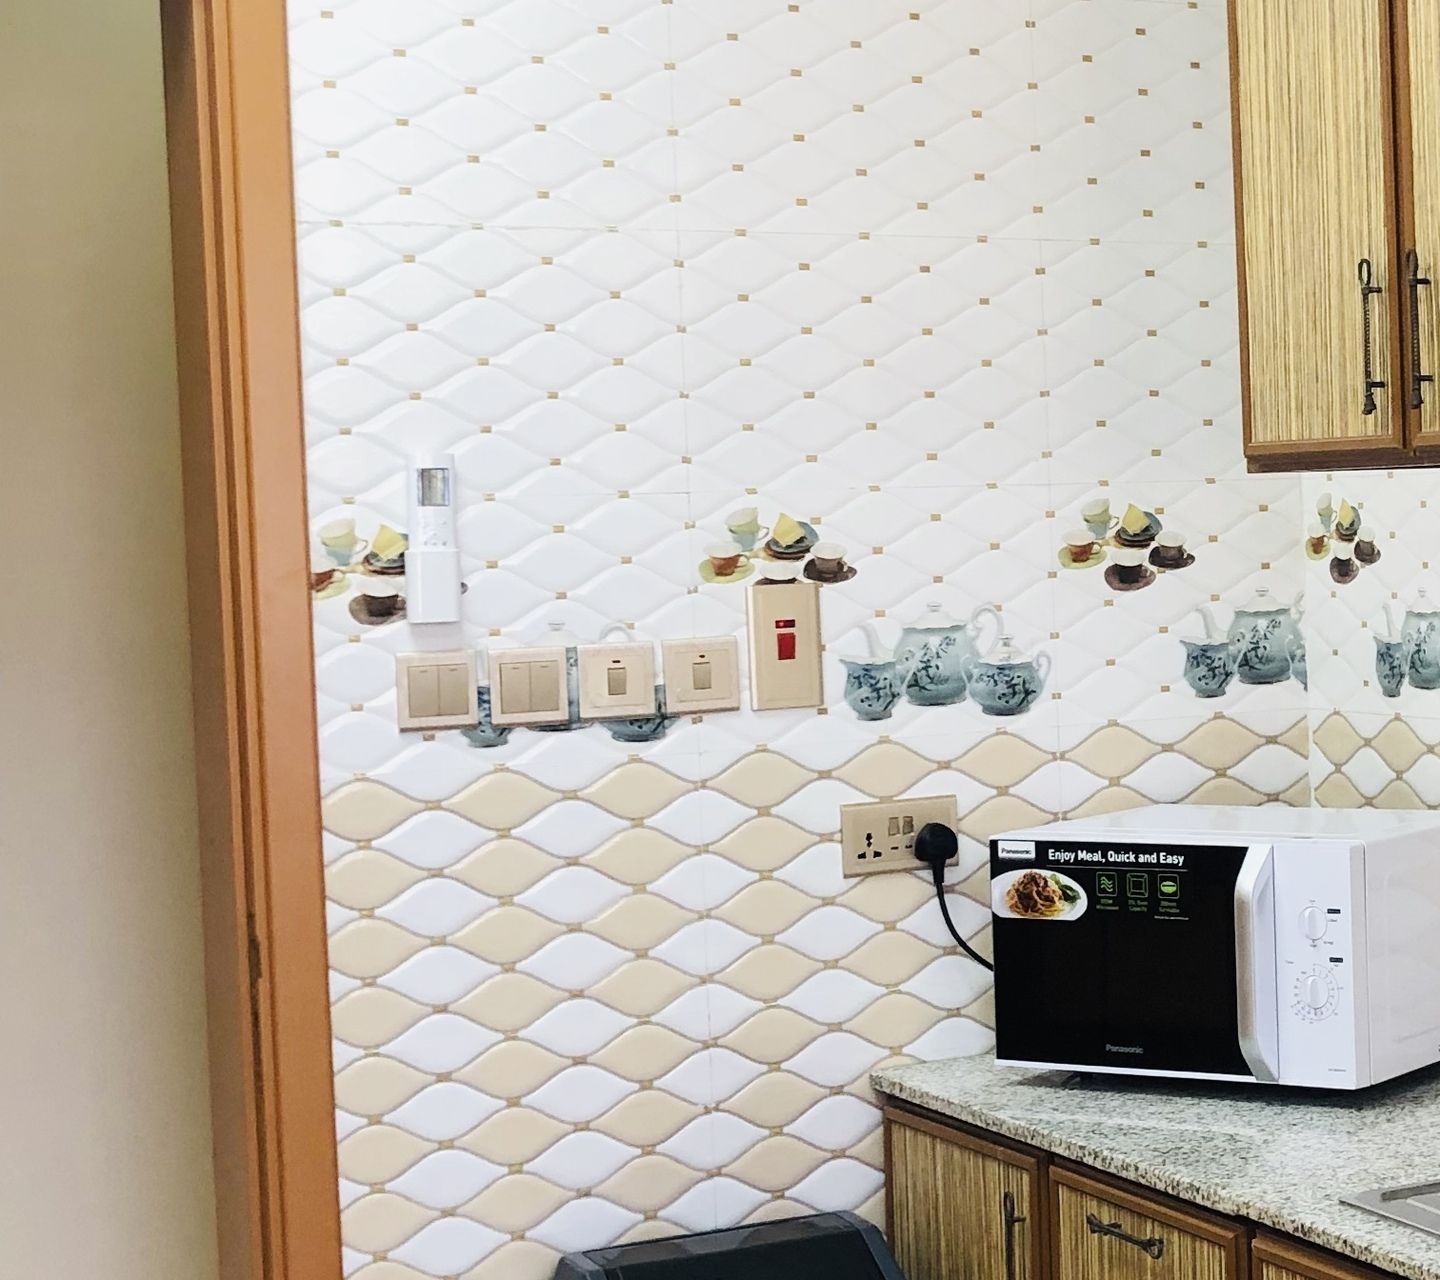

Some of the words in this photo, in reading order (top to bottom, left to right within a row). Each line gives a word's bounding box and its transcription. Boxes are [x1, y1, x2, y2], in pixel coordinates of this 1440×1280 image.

[1048, 848, 1075, 863] Enjoy
[1077, 849, 1105, 863] Meal,
[1107, 850, 1136, 863] Quick
[1138, 851, 1157, 863] and
[1159, 852, 1184, 867] Easy
